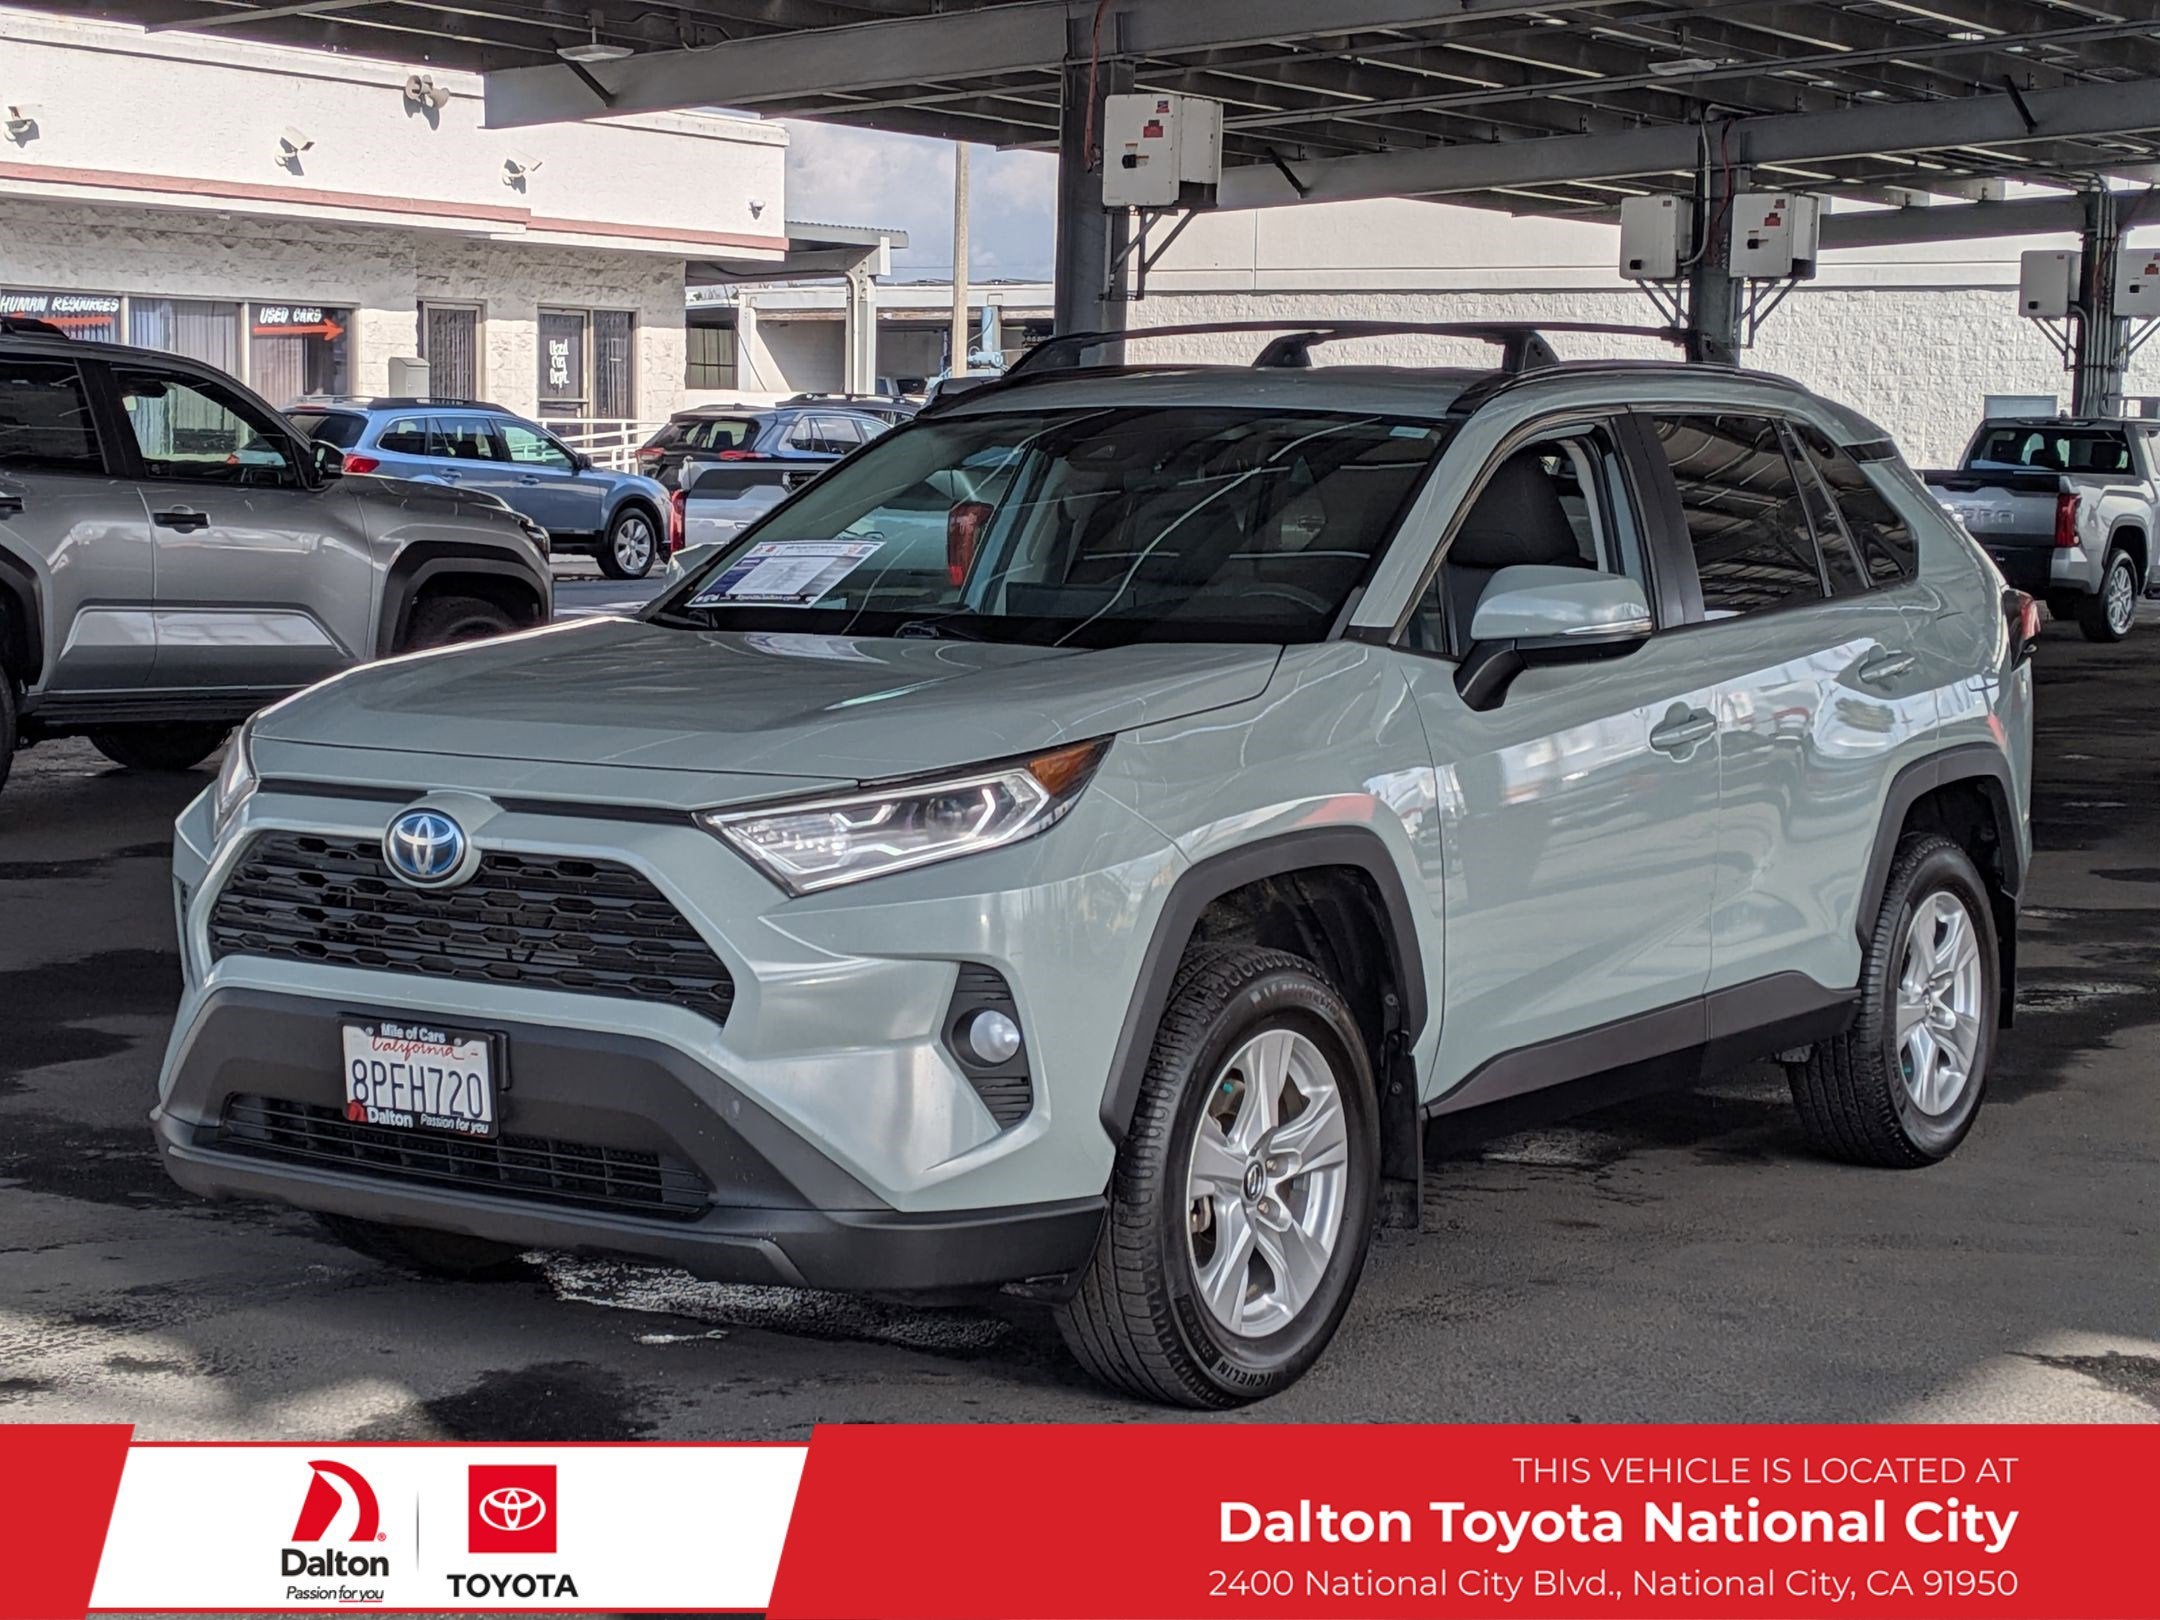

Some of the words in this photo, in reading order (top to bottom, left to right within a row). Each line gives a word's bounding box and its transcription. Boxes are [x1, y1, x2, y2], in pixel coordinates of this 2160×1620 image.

[0, 295, 48, 312] HUMAN
[51, 296, 120, 312] RESOURCES
[260, 307, 289, 324] USED
[293, 307, 322, 323] CARS
[381, 1023, 404, 1038] Mile
[405, 1026, 418, 1040] of
[419, 1028, 446, 1043] Cars
[372, 1036, 465, 1061] California
[352, 1058, 484, 1118] 8PFH720
[367, 1106, 414, 1128] Dalton
[420, 1113, 455, 1129] Passion
[455, 1116, 470, 1131] for
[470, 1122, 489, 1135] you
